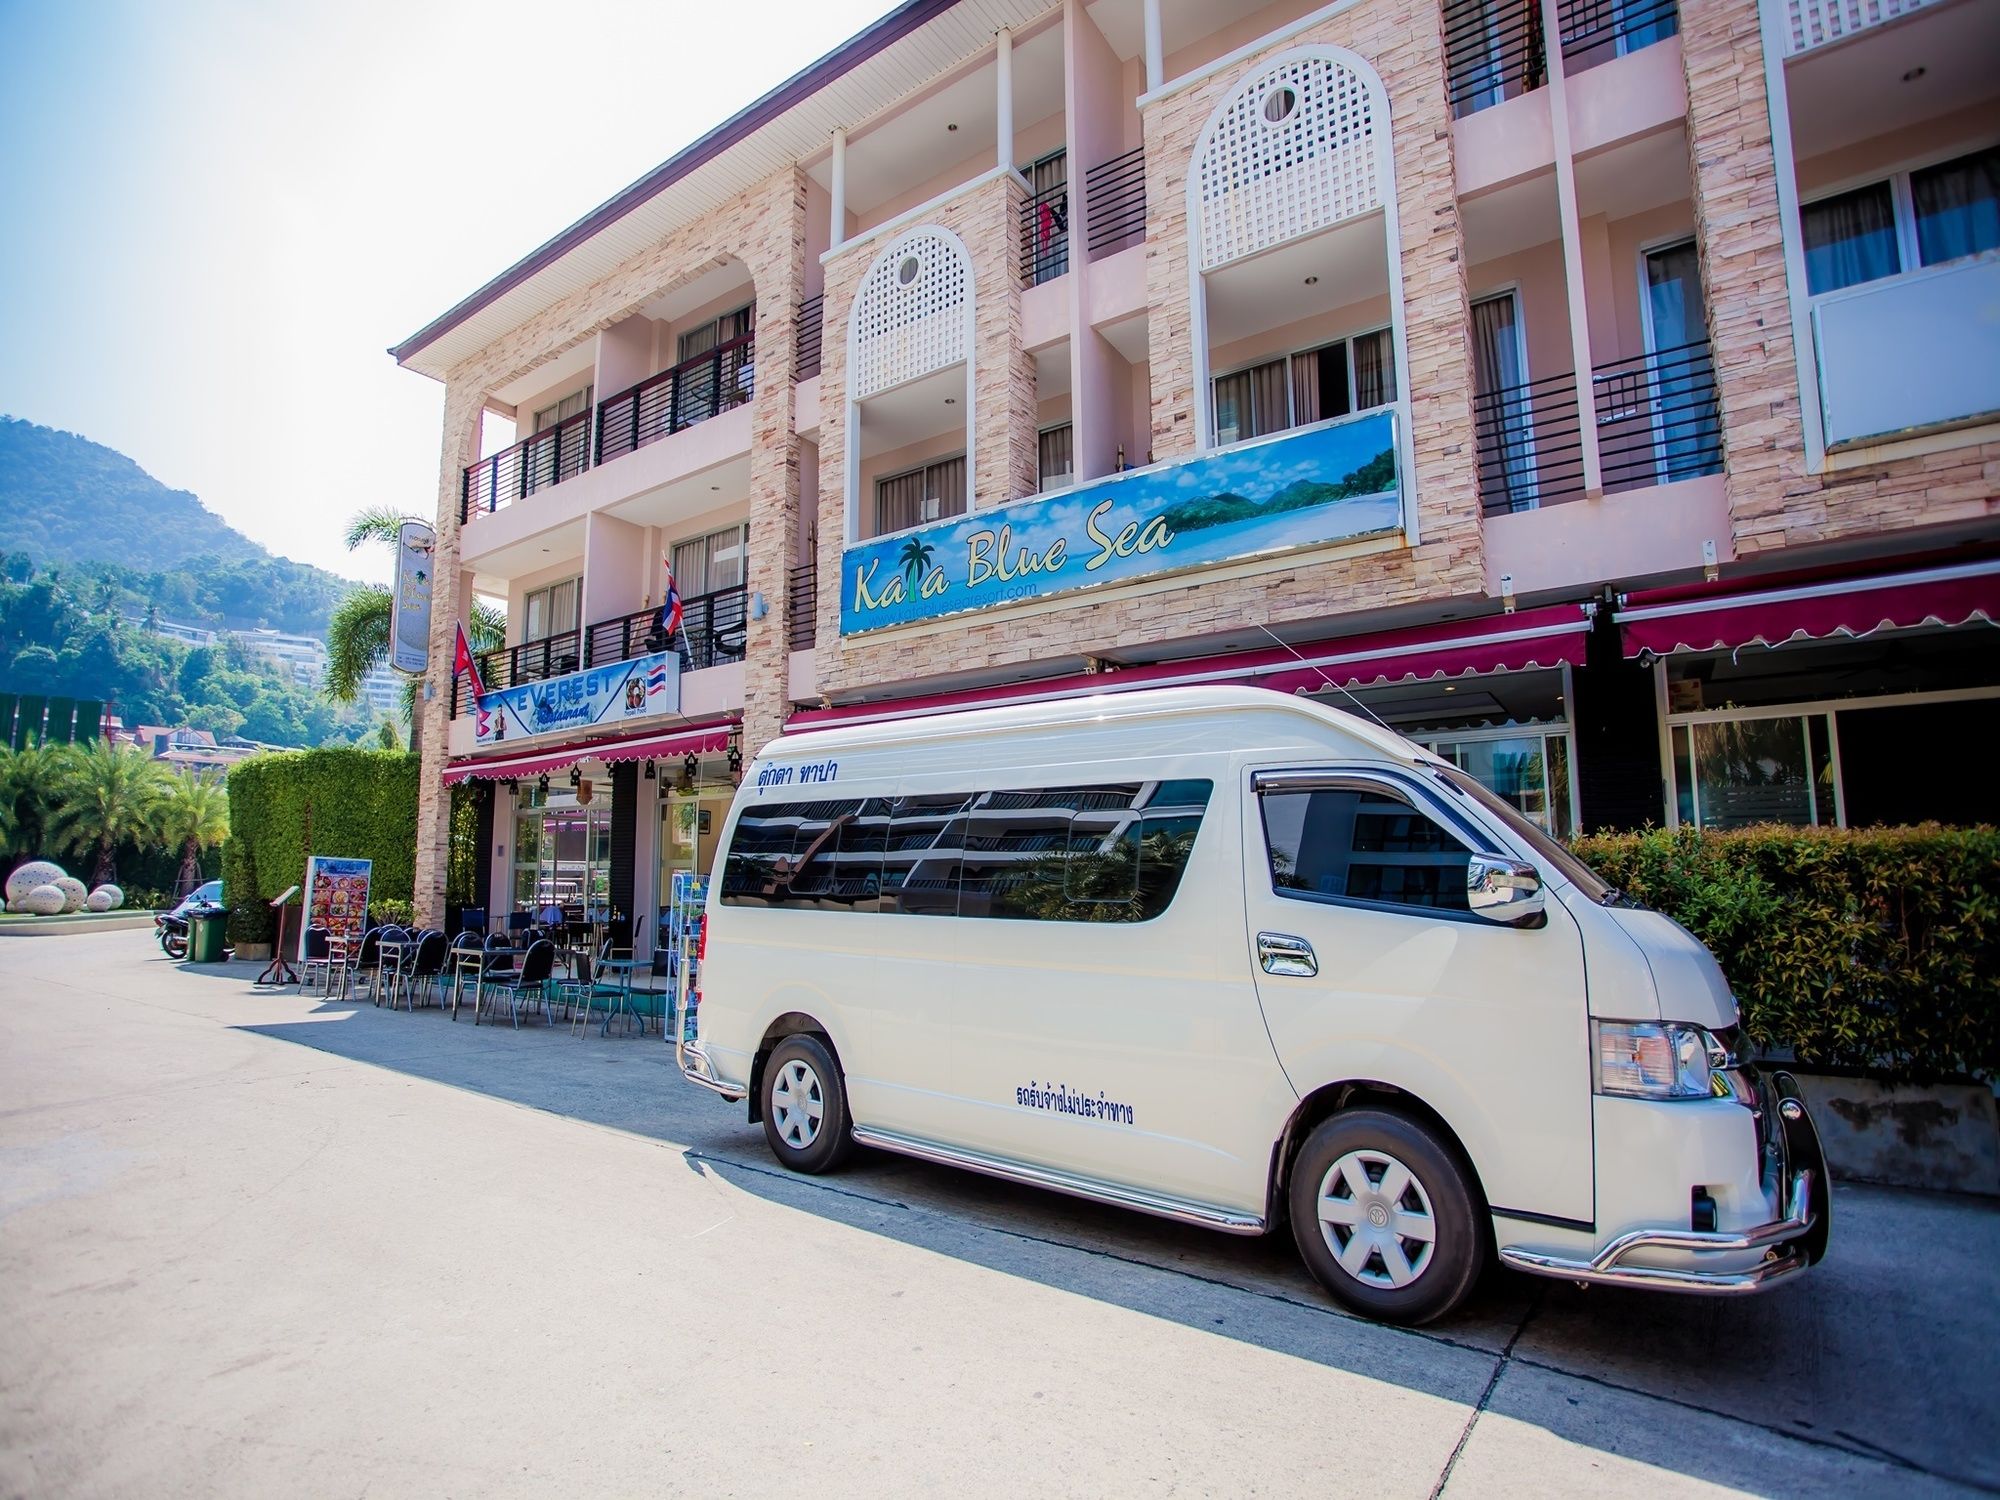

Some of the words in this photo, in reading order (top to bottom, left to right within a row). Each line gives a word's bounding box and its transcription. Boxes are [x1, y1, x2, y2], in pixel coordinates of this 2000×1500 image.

[966, 525, 1068, 588] Blue
[1085, 498, 1175, 571] Sea
[517, 671, 613, 711] EVEREST
[1016, 1080, 1134, 1125] รถรับจ้างไม่ประจำทาง
